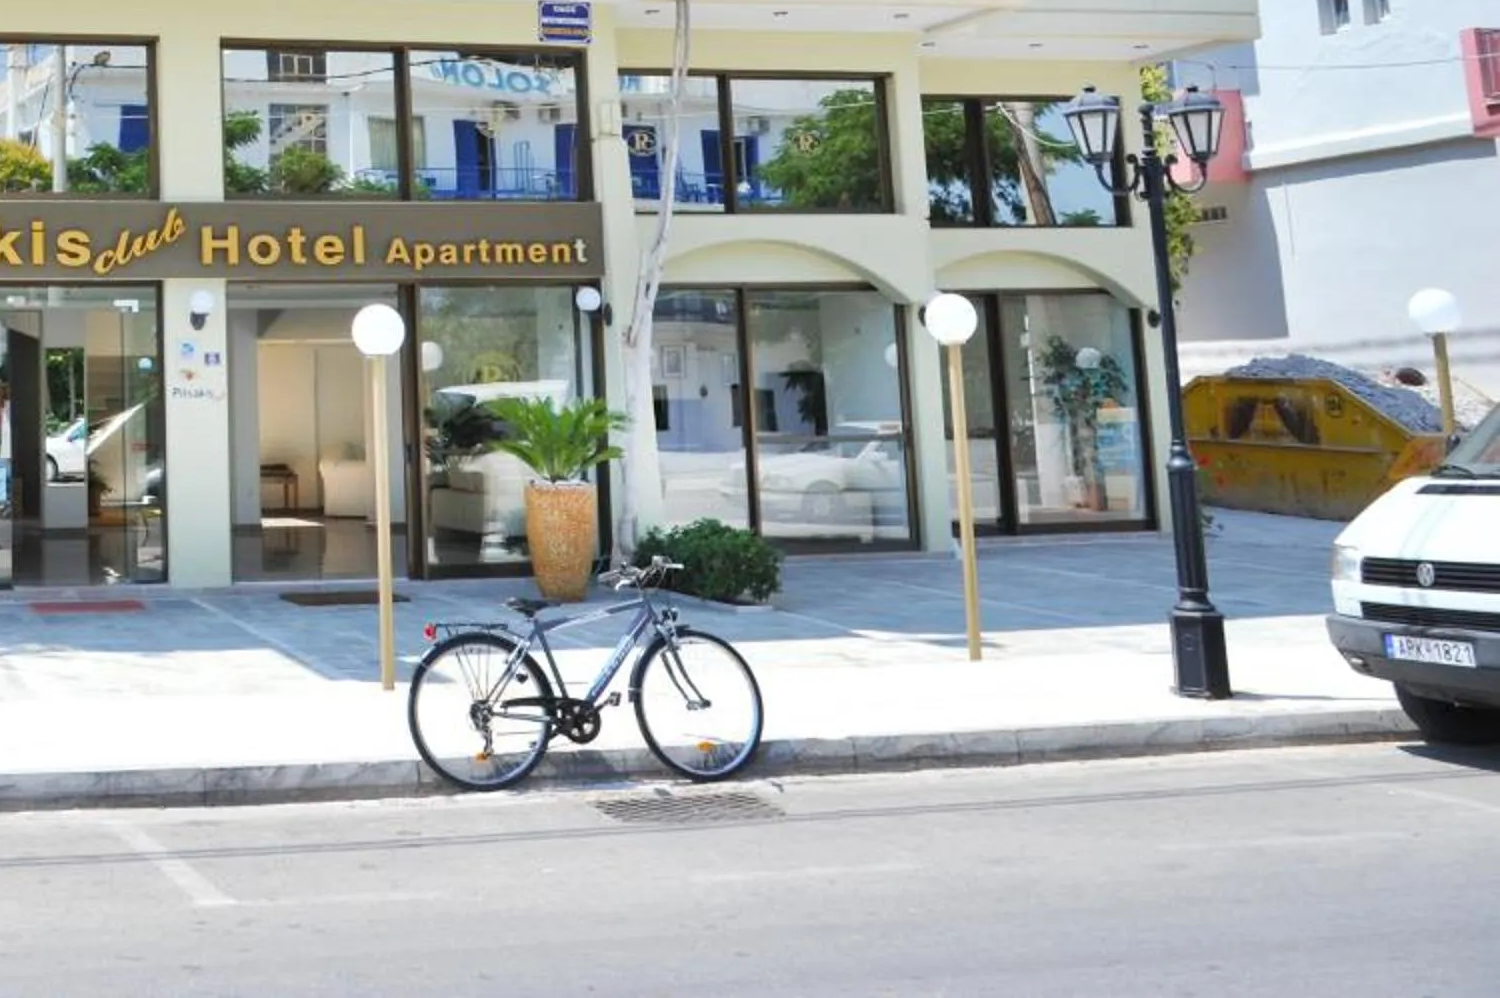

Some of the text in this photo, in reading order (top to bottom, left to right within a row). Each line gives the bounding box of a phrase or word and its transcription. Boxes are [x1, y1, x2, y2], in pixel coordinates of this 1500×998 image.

[92, 206, 186, 275] club
[201, 224, 366, 266] Hotel
[386, 238, 589, 271] Apartment
